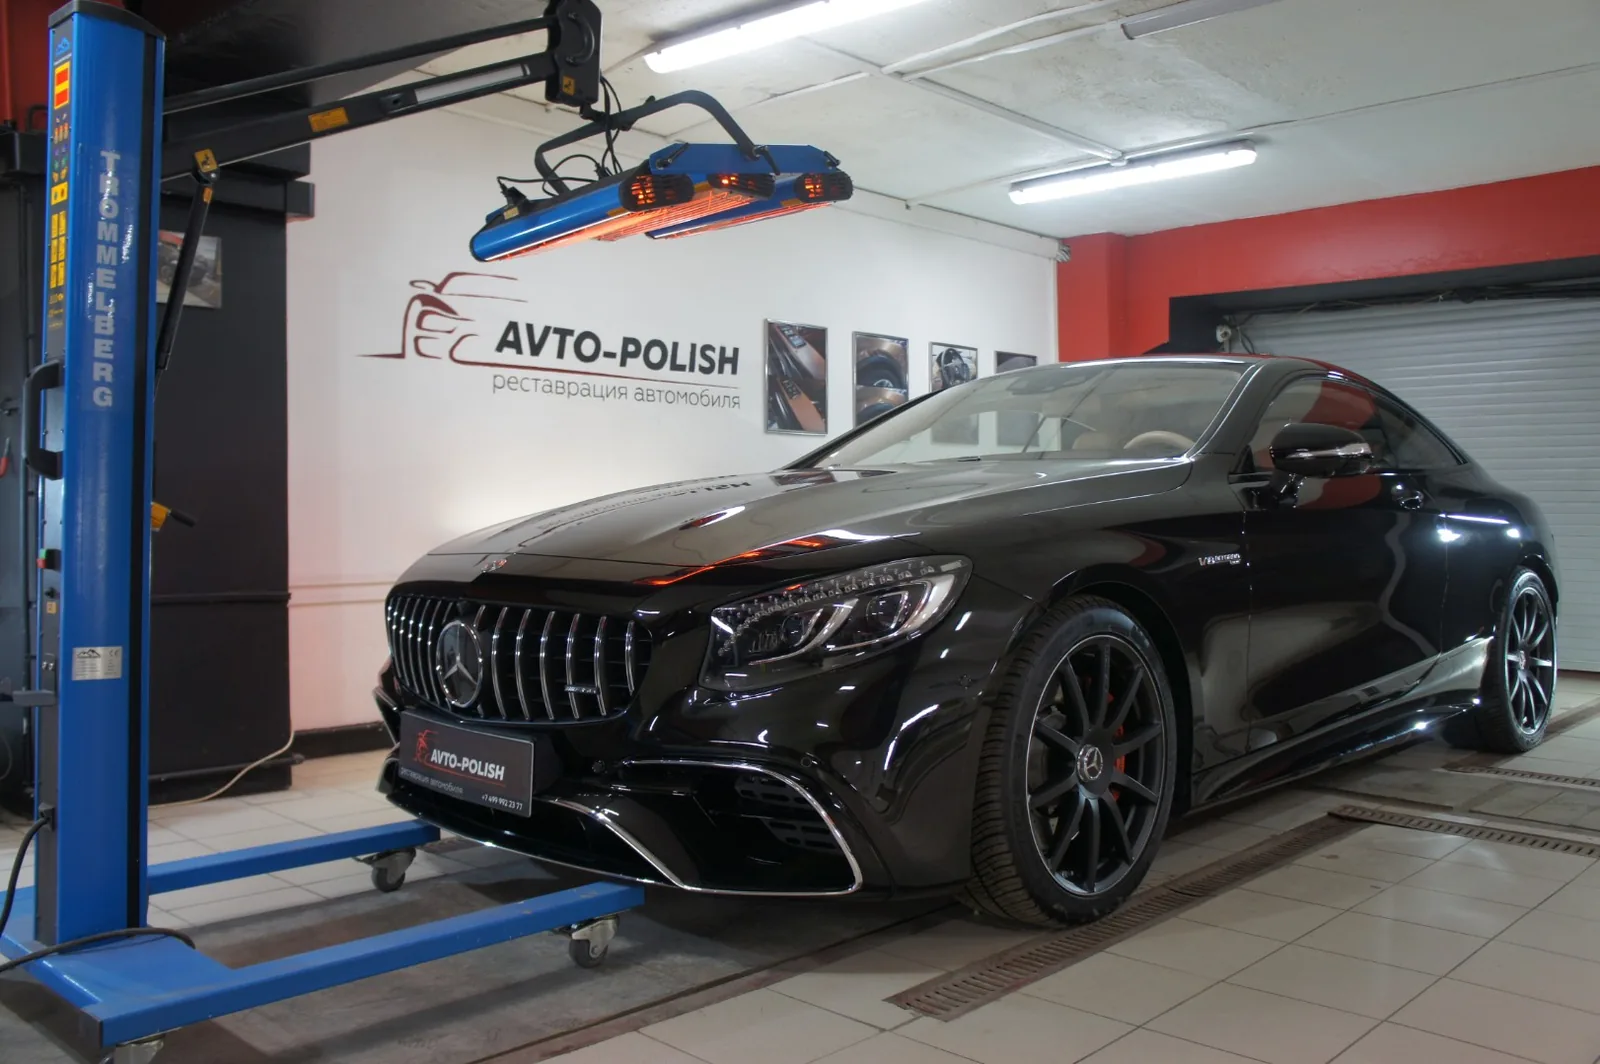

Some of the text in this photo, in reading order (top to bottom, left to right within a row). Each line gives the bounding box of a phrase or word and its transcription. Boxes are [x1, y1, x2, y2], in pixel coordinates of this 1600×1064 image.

[93, 150, 121, 408] TROMMELBERG
[495, 320, 740, 376] AVTO-POLISH
[492, 373, 741, 410] реставрация автомобиля
[431, 749, 505, 780] AVTO-POLISH
[508, 800, 515, 809] 23
[516, 802, 523, 811] 77
